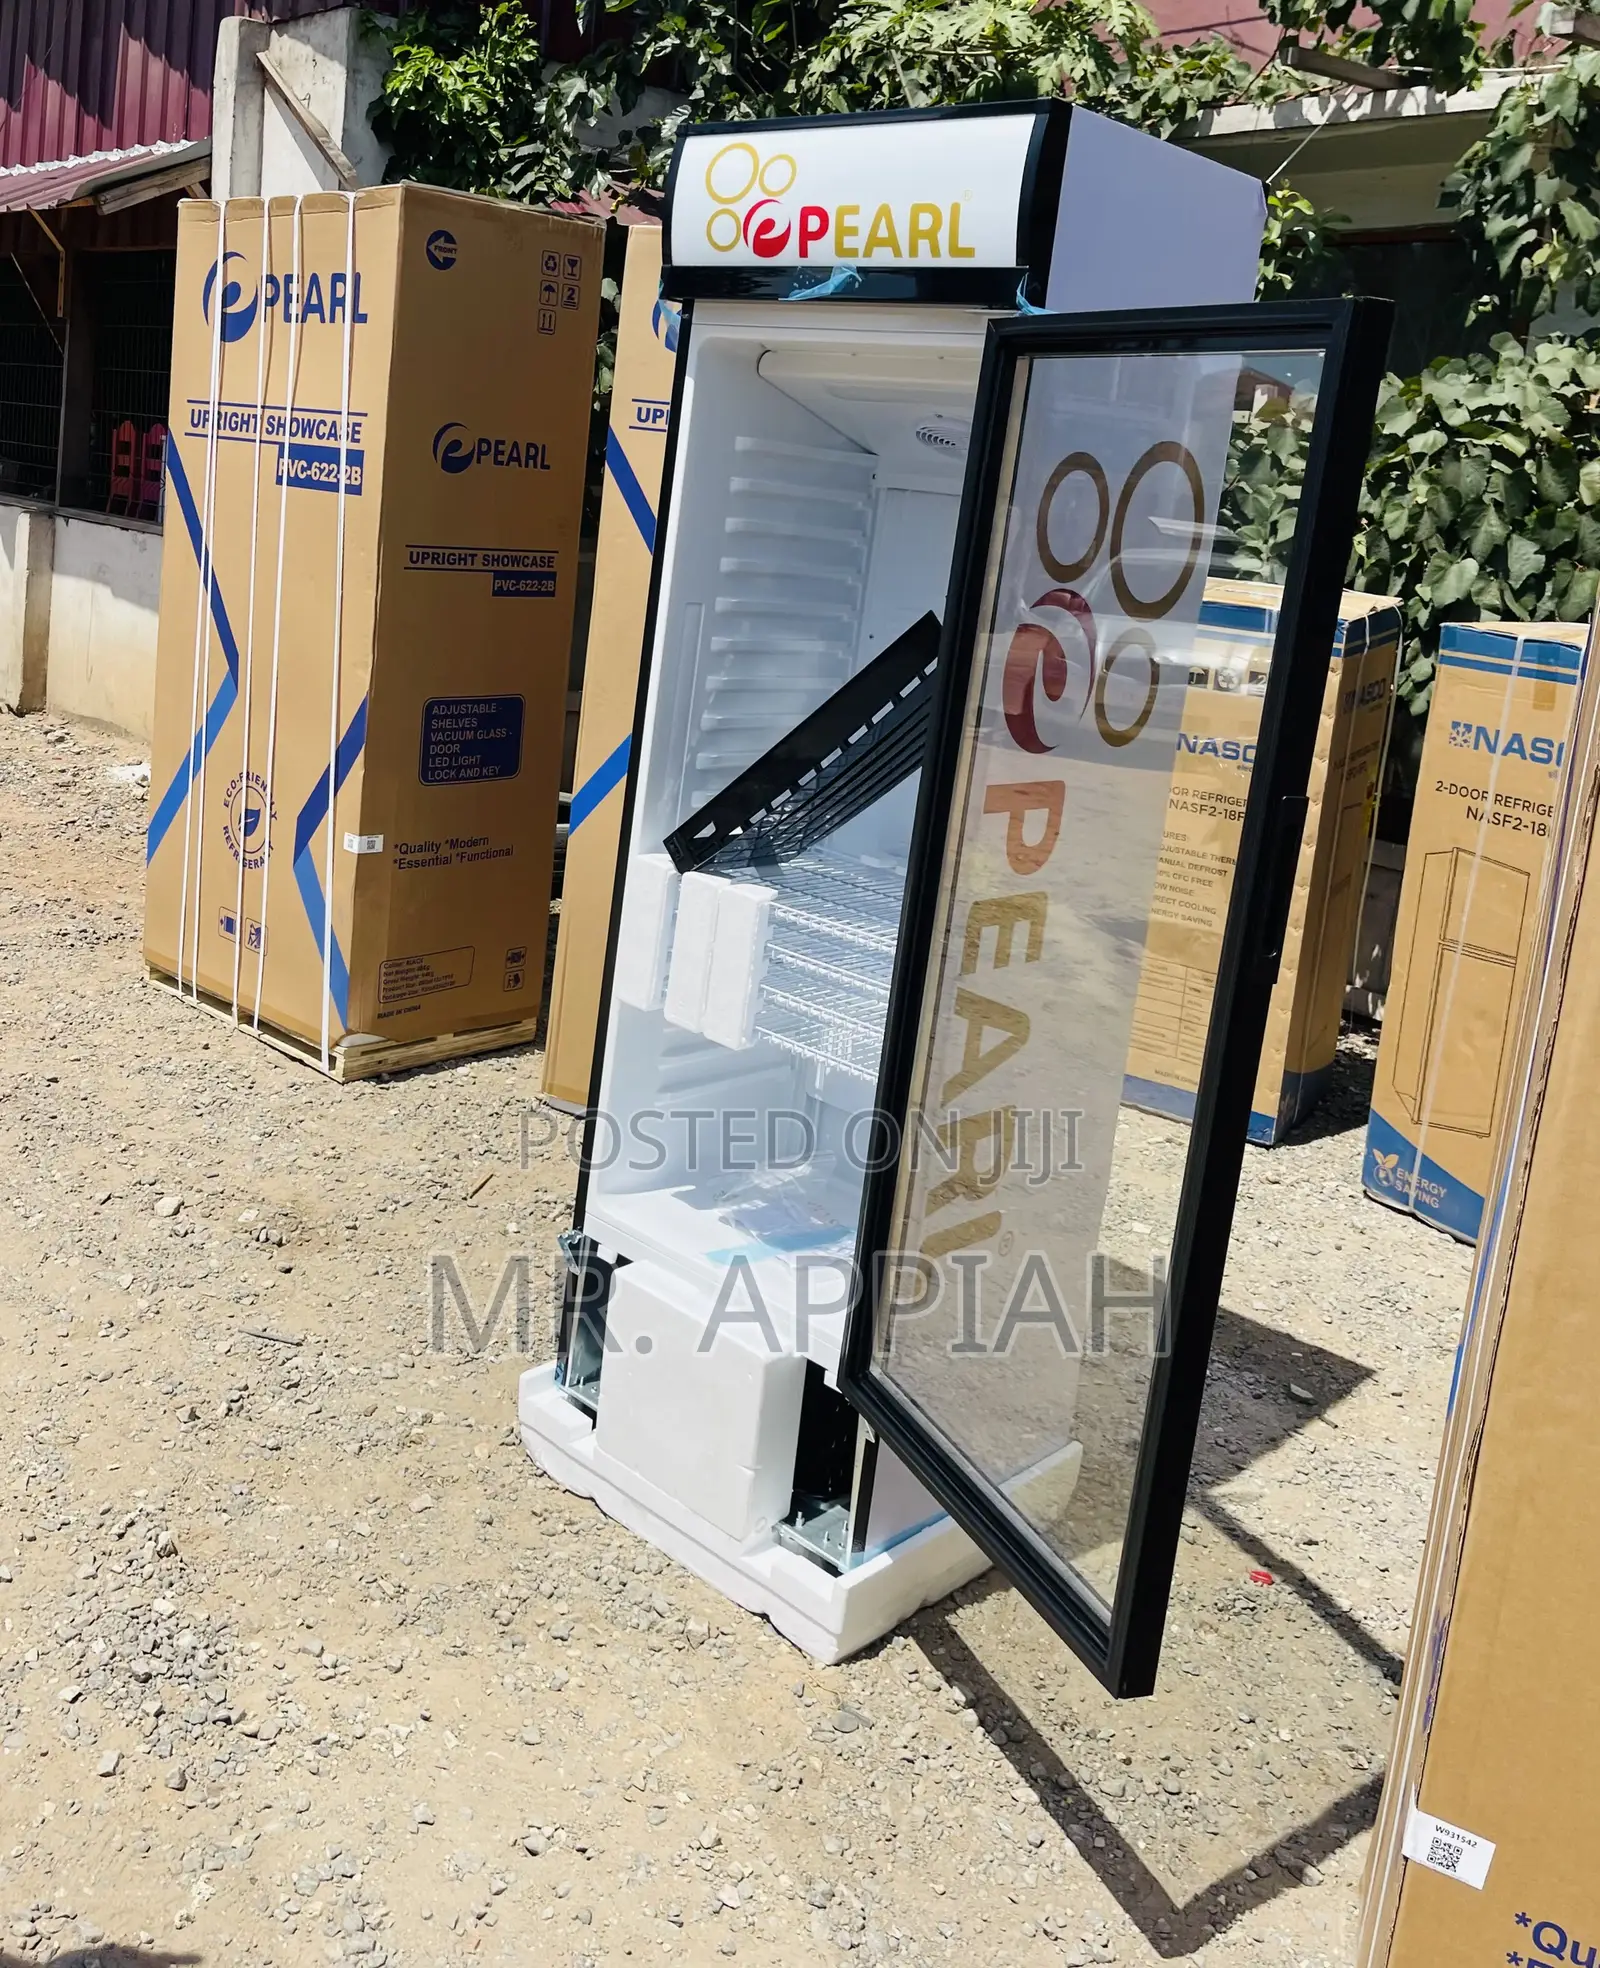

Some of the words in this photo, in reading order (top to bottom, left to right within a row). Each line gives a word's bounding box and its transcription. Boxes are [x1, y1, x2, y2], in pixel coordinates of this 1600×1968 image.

[799, 202, 976, 259] PEARL
[434, 245, 458, 255] FRONT
[261, 272, 368, 324] PEARL
[190, 408, 262, 434] UPRIGHT
[636, 406, 669, 425] UP
[476, 437, 551, 470] PEARL
[278, 457, 362, 486] PVC-622-2B
[409, 550, 478, 567] UPRIGHT
[481, 554, 555, 569] SHOWCASE
[494, 579, 555, 592] PVC-622-2B
[432, 703, 497, 715] ADJUSTABLE
[431, 718, 478, 729] SHELVES
[430, 731, 474, 742] VACUUM
[476, 728, 507, 739] GLASS
[429, 743, 460, 755] DOOR
[428, 757, 449, 768] LED
[452, 755, 482, 766] LIGHT
[428, 769, 457, 780] LOCK
[459, 767, 481, 778] AND
[482, 765, 501, 777] KEY
[223, 771, 278, 820] ECO-FRIENY
[1168, 786, 1189, 797] OR
[1435, 780, 1489, 801] 2-DOOR
[1494, 793, 1554, 818] REFRIGE
[1169, 798, 1245, 822] NASF2-18F
[1466, 805, 1550, 838] NSF2-18
[223, 825, 274, 869] REFRGERAT
[1157, 856, 1186, 868] ANUAL
[1187, 862, 1228, 878] DEFROST
[1168, 884, 1195, 896] NOISE
[1190, 876, 1214, 888] FREE
[1178, 900, 1217, 915] COOLING
[1181, 914, 1213, 927] SAVING
[914, 780, 1066, 1303] PEARL
[1396, 1167, 1447, 1198] ENERGY
[1394, 1180, 1440, 1208] SAVING
[1436, 1824, 1478, 1848] W931542
